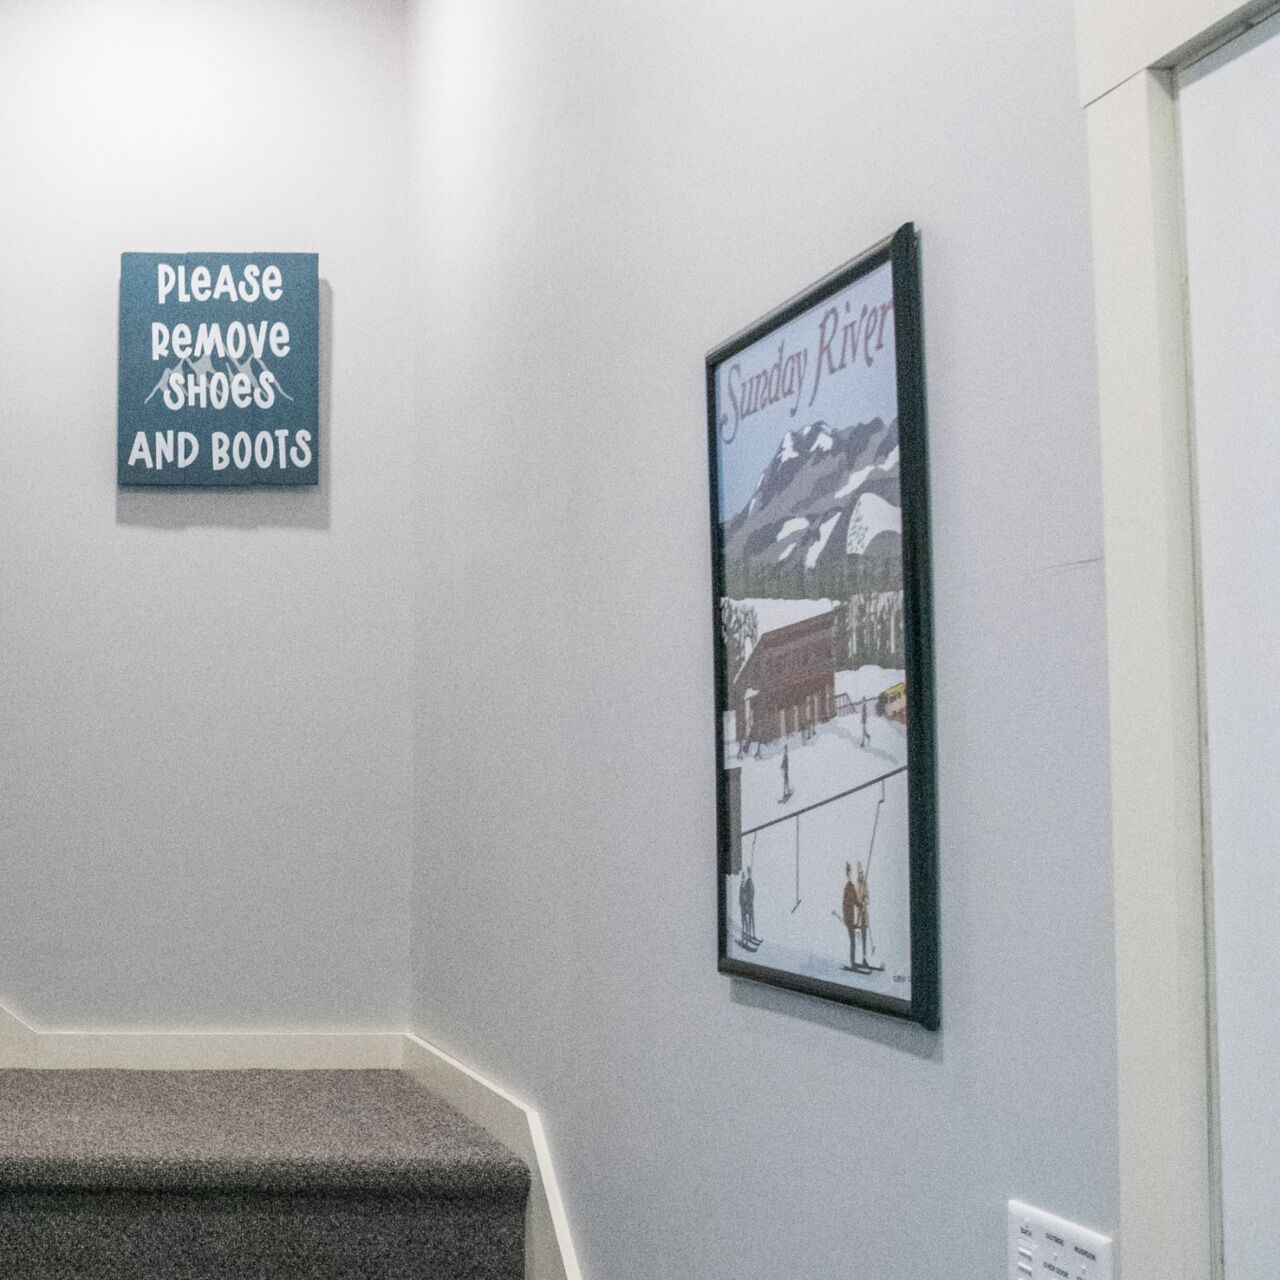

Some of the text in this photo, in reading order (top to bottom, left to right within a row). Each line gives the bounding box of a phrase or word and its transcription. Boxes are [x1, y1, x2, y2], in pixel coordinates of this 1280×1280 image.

[721, 300, 895, 445] Sunday River
[127, 429, 312, 470] AND BOOTS
